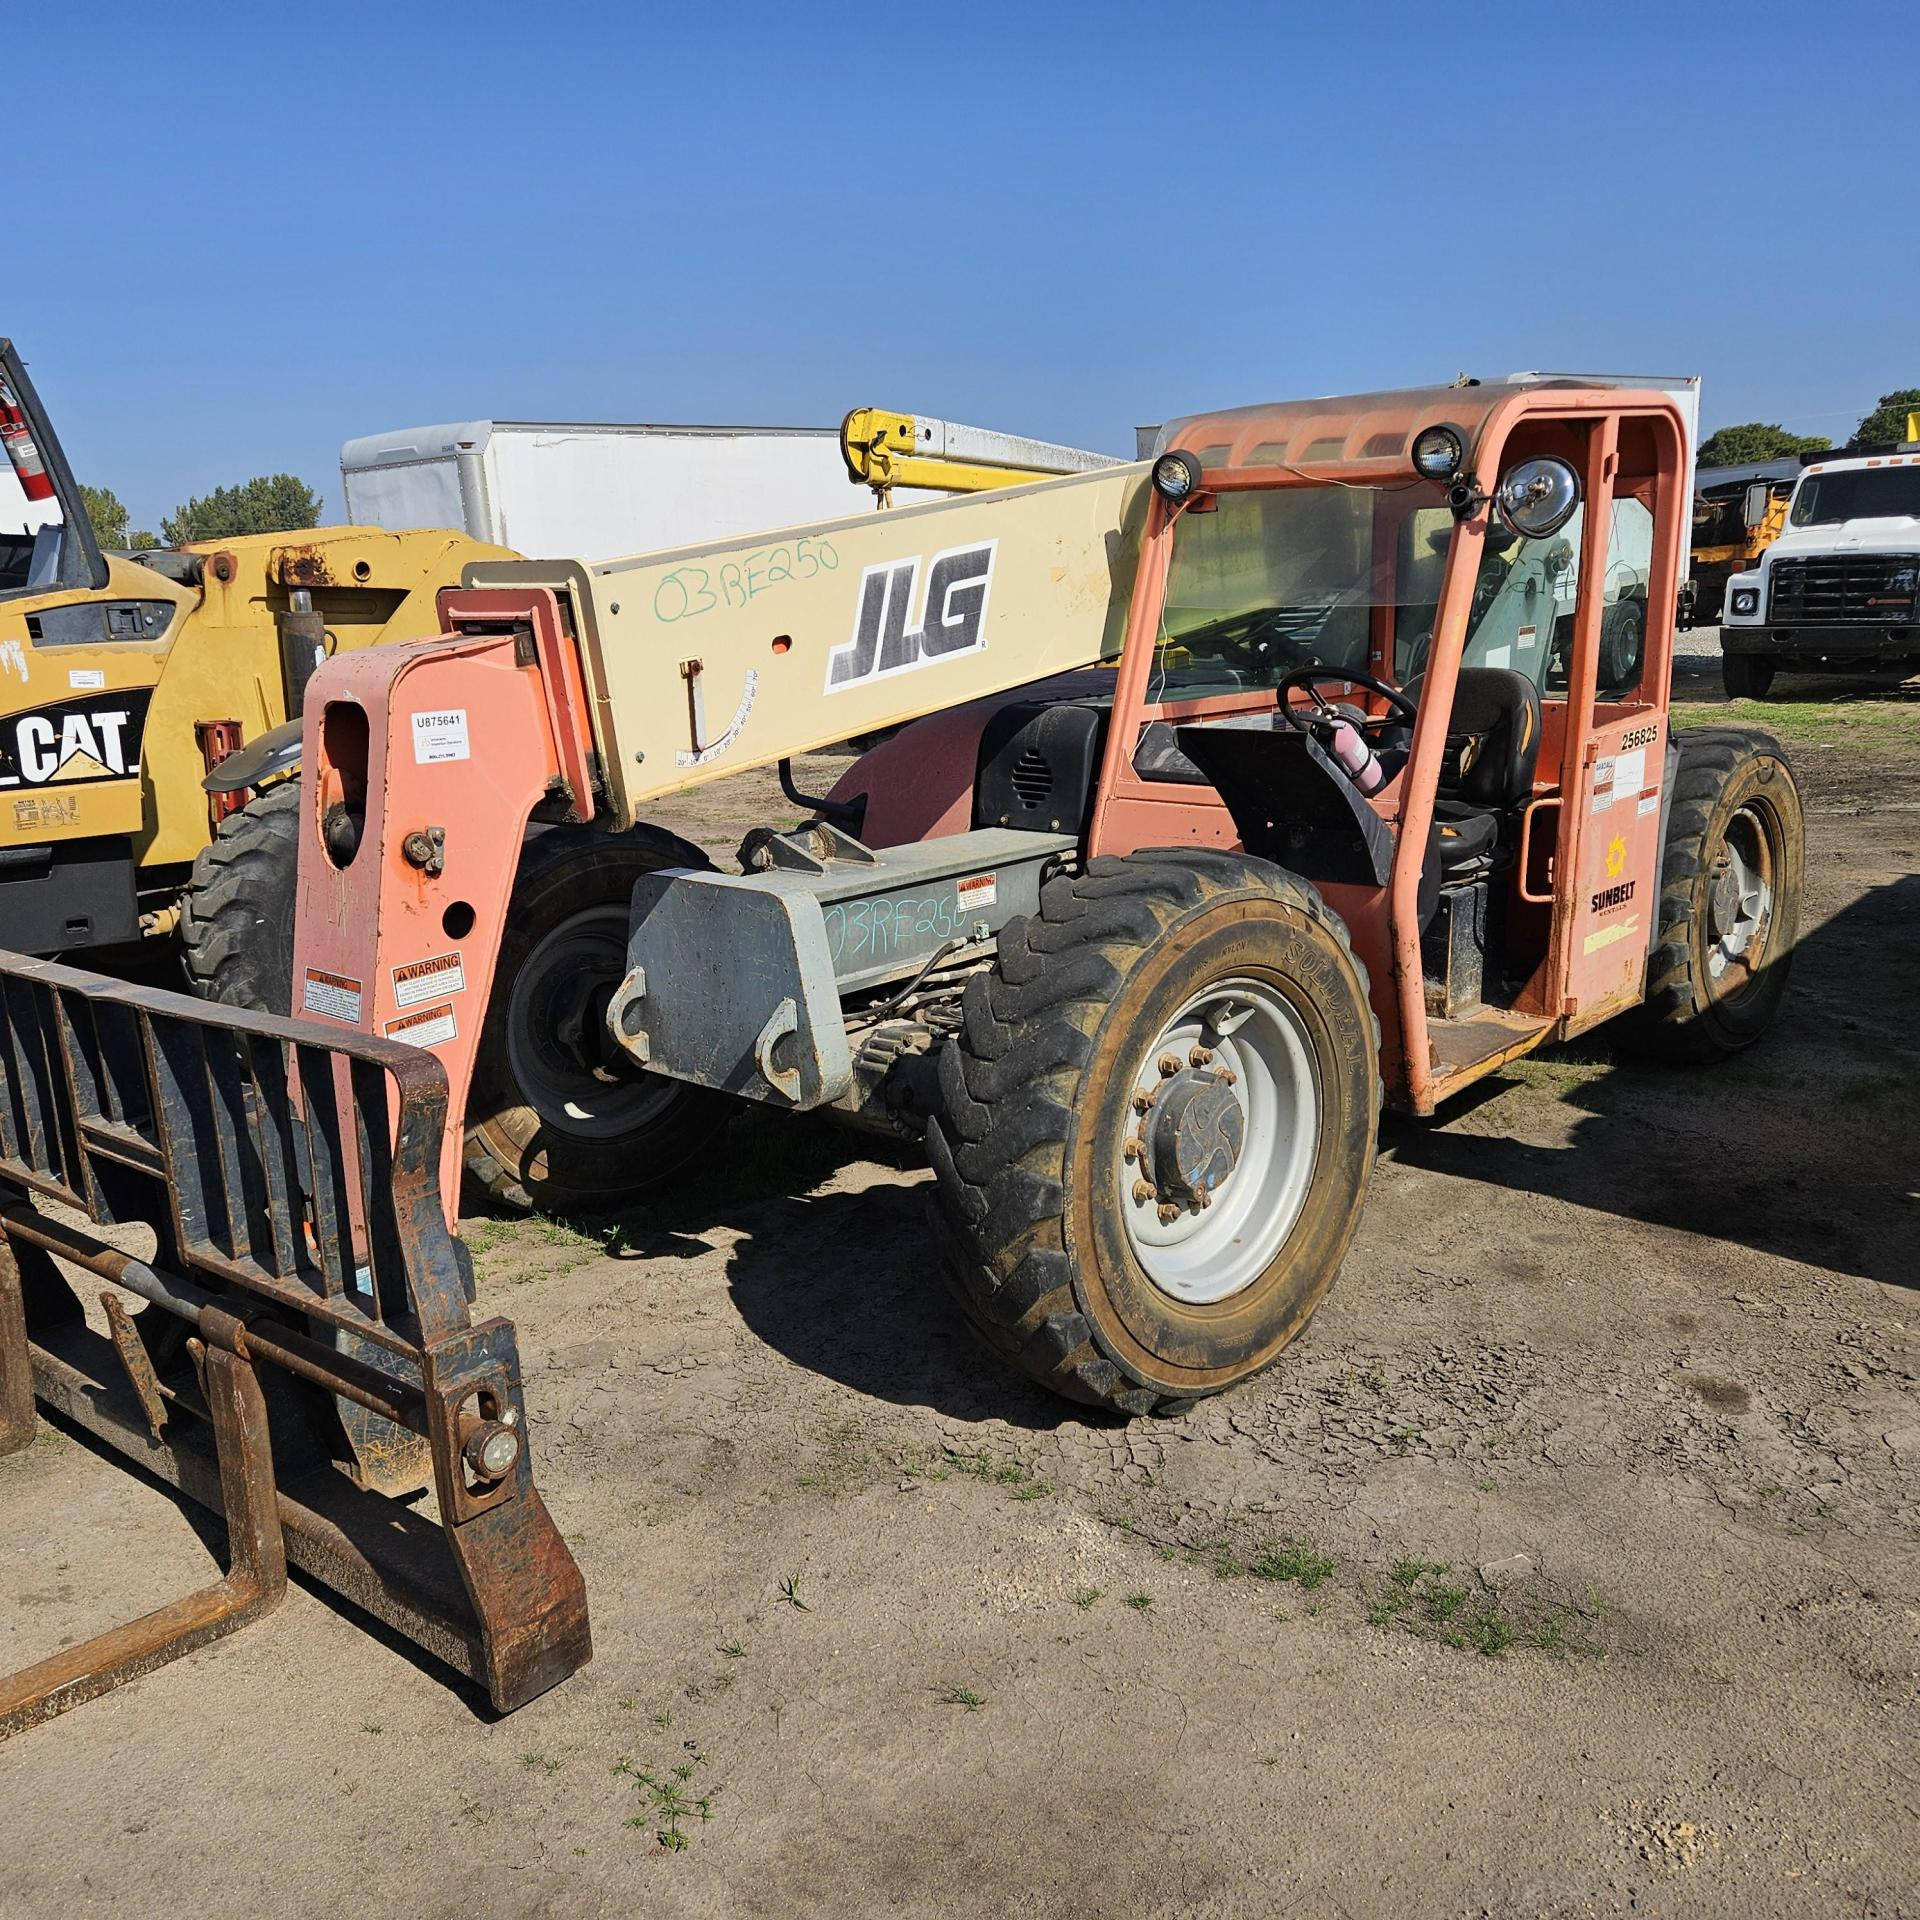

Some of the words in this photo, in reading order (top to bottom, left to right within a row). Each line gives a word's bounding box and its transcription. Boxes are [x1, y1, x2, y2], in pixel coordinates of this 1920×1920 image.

[823, 538, 999, 695] JLG
[417, 715, 460, 728] U875641
[16, 711, 127, 783] CAT
[1621, 725, 1658, 751] 256825
[1591, 880, 1636, 913] SUNBELT
[408, 955, 459, 979] WARNING
[405, 1009, 443, 1028] WARNING
[1283, 938, 1364, 1078] SOLIDEAL
